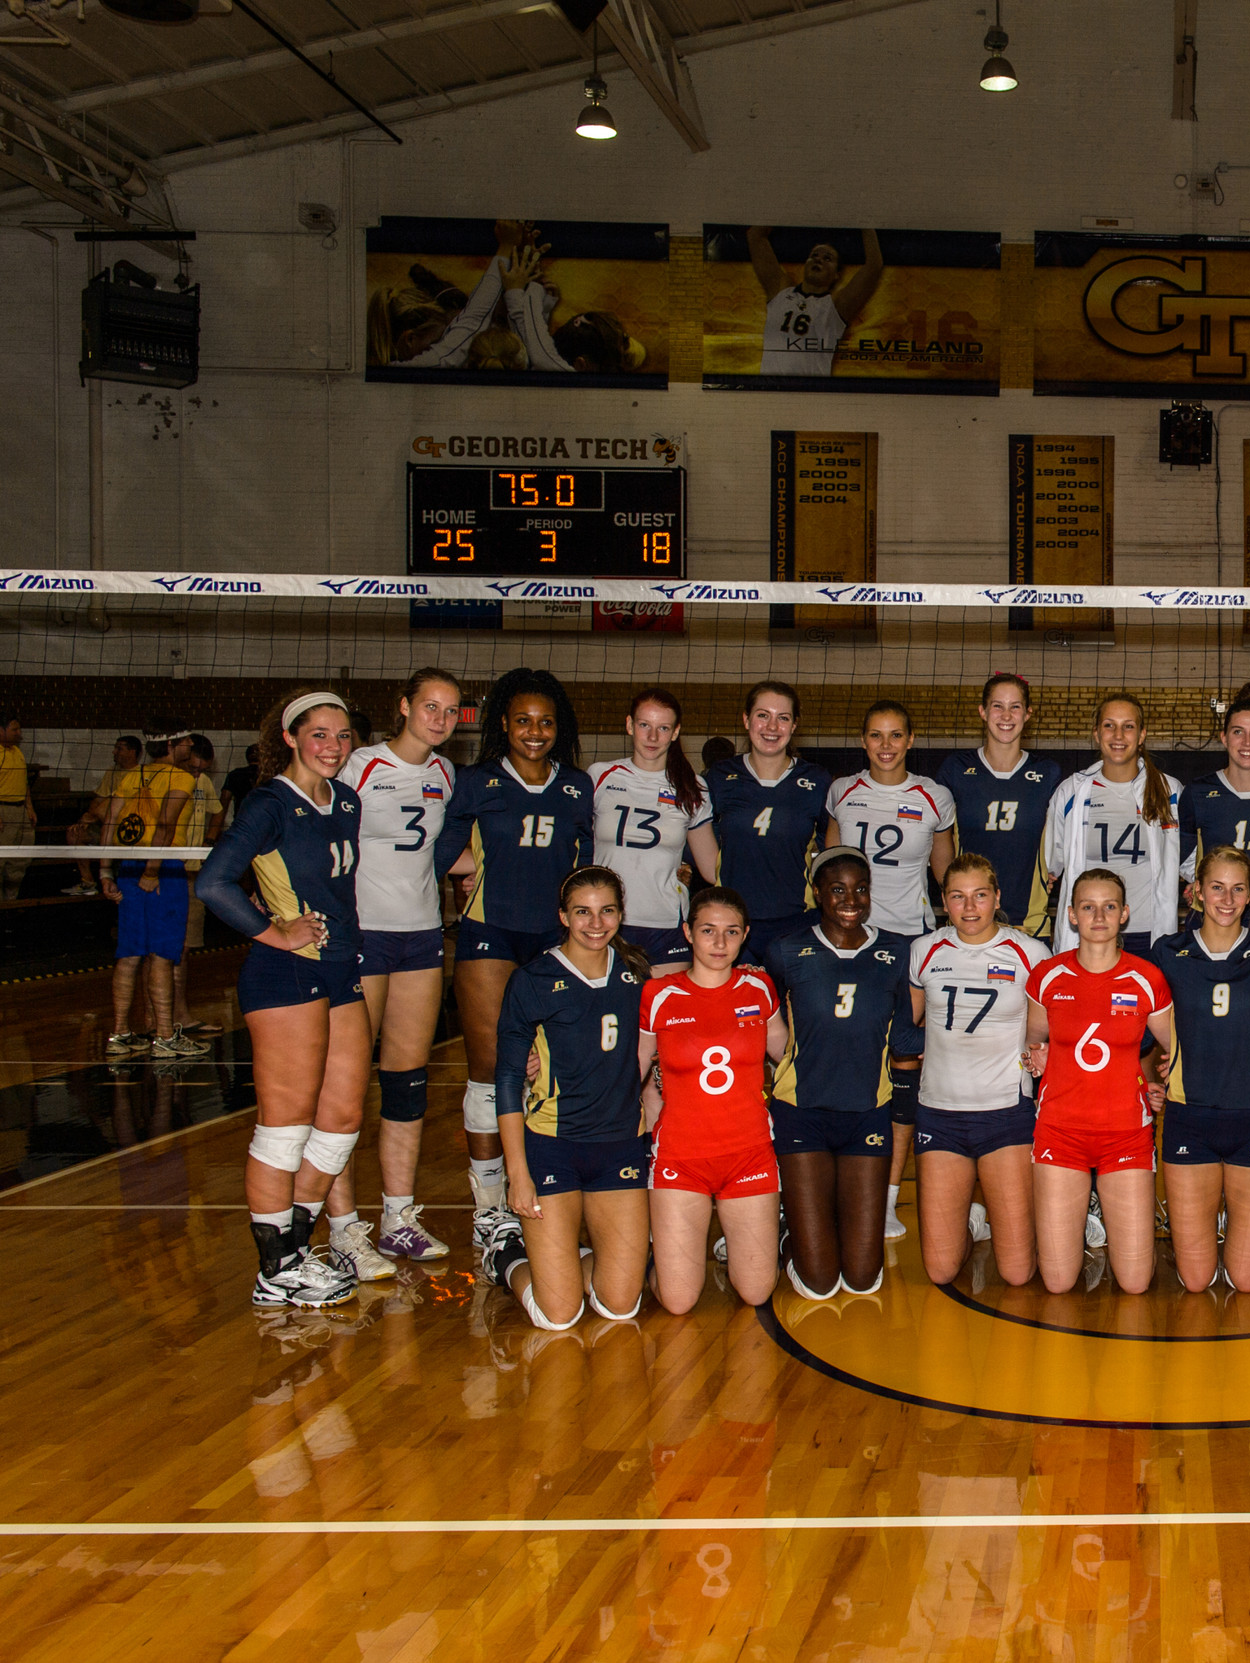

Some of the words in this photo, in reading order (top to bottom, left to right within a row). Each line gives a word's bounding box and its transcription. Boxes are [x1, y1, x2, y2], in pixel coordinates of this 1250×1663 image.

[781, 310, 810, 335] 16
[786, 338, 851, 352] KELE
[859, 340, 984, 354] EVELAND
[448, 436, 571, 459] GEORGIA
[576, 438, 648, 460] TECH
[777, 440, 787, 473] ACC
[799, 445, 845, 453] 1994
[1035, 444, 1075, 452] 1994
[815, 458, 861, 466] 1995
[1016, 443, 1025, 488] NCAA
[799, 470, 848, 479] 2000
[499, 473, 575, 506] 75.0
[799, 495, 847, 503] 2004
[812, 483, 861, 491] 2003
[1035, 493, 1075, 501] 2001
[422, 509, 477, 525] HOME
[613, 512, 676, 527] GUEST
[1035, 517, 1078, 525] 2003
[1057, 505, 1099, 513] 2002
[526, 519, 573, 530] PERIOD
[1058, 529, 1099, 537] 2004
[433, 529, 475, 562] 25
[540, 530, 557, 562] 3
[643, 532, 671, 564] 18
[1016, 491, 1025, 585] TOURNAME
[545, 605, 581, 613] POWER
[797, 778, 816, 791] GT
[1024, 770, 1043, 782] GT
[562, 784, 582, 799] GT
[341, 801, 355, 813] GT
[985, 801, 1019, 831] 13
[395, 805, 426, 851] 3
[519, 814, 555, 848] 15
[614, 804, 662, 850] 13
[753, 806, 774, 837] 4
[856, 821, 904, 867] 12
[1094, 822, 1146, 865] 14
[329, 840, 354, 878] 14
[873, 950, 895, 965] GT
[834, 983, 857, 1019] 3
[940, 984, 998, 1034] 17
[1212, 983, 1231, 1017] 9
[601, 1013, 619, 1052] 6
[1074, 1022, 1111, 1073] 6
[698, 1045, 735, 1096] 8
[917, 1132, 932, 1145] 17
[619, 1166, 640, 1180] GT
